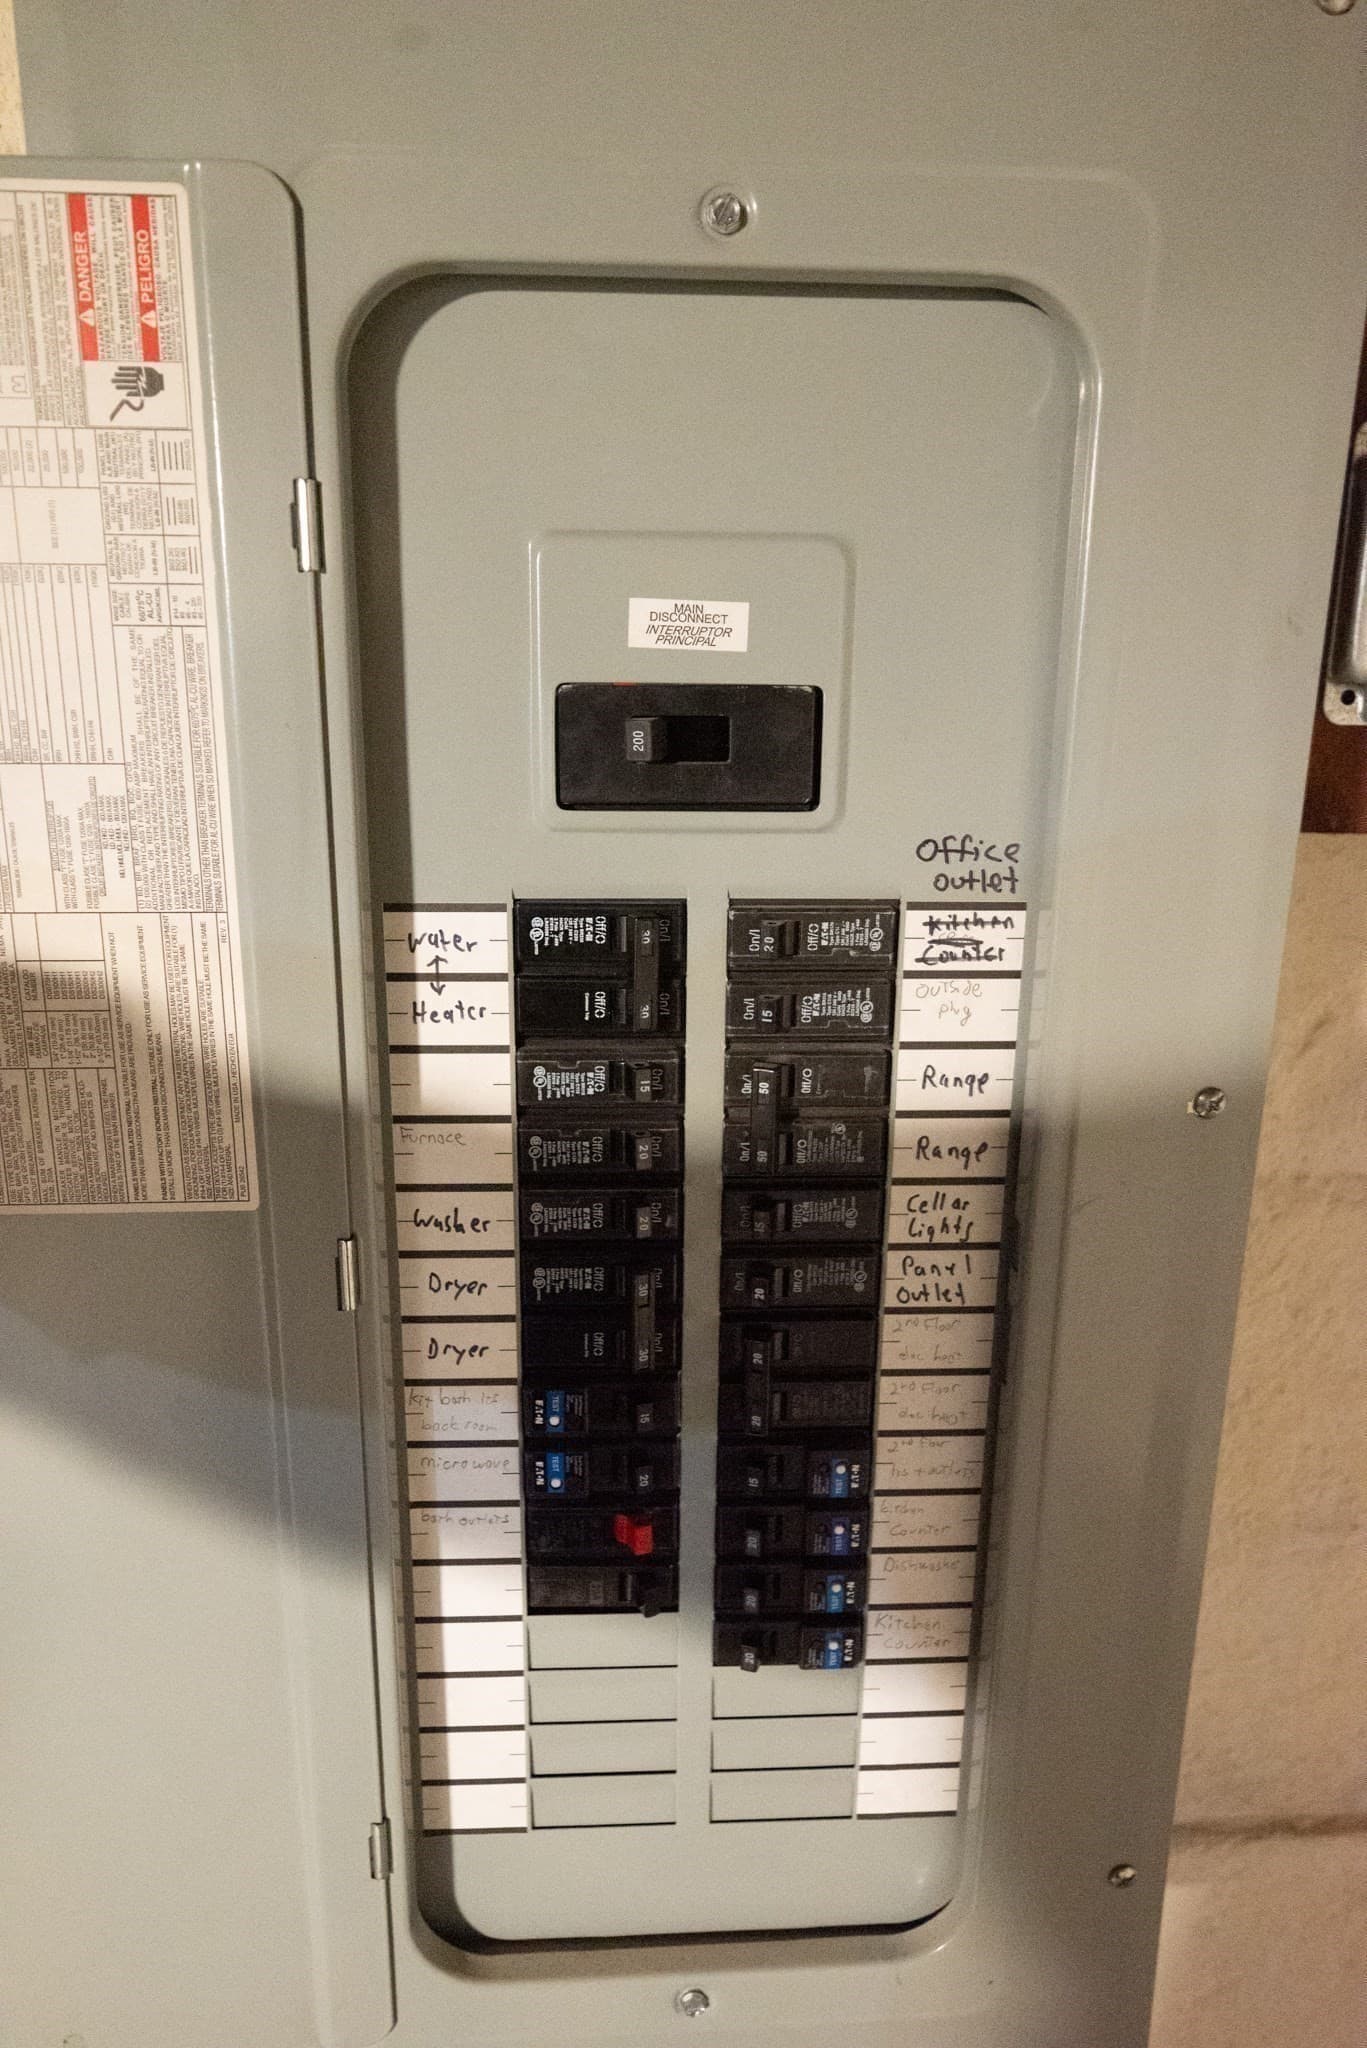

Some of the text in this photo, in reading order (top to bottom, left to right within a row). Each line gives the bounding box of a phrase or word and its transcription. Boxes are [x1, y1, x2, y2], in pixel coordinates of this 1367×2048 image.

[74, 230, 92, 301] DANGER
[136, 229, 153, 303] PELIGRO
[674, 604, 704, 614] MAIN
[650, 611, 728, 624] DISCONNECT
[646, 625, 732, 638] INTERRUPTOR
[656, 635, 717, 646] PRINCIPAL
[184, 634, 194, 664] BREAKER
[633, 731, 644, 752] 200
[199, 810, 208, 838] BREAKER
[201, 839, 209, 855] THAN
[916, 835, 1020, 864] Office
[202, 857, 211, 877] OTHER
[933, 866, 1018, 893] outlet
[641, 929, 649, 944] 30
[764, 937, 774, 952] 20
[412, 1000, 486, 1024] Heater
[640, 1004, 649, 1018] 30
[762, 1010, 773, 1022] 15
[640, 1080, 649, 1093] 15
[921, 1065, 988, 1096] Range
[759, 1082, 769, 1094] 50
[400, 1127, 466, 1145] Furnace
[639, 1145, 648, 1159] 20
[757, 1151, 767, 1162] 50
[916, 1136, 988, 1169] Range
[907, 1192, 970, 1214] Cellar
[639, 1216, 648, 1231] 20
[755, 1222, 764, 1232] 15
[428, 1272, 487, 1300] Dryer
[638, 1283, 648, 1296] 30
[754, 1288, 764, 1299] 20
[427, 1337, 489, 1365] Dryer
[639, 1348, 648, 1361] 30
[753, 1353, 763, 1364] 20
[752, 1416, 760, 1426] 20
[551, 1456, 559, 1472] TEST
[639, 1475, 648, 1486] 20
[748, 1478, 758, 1488] 15
[748, 1537, 756, 1548] 20
[746, 1596, 756, 1608] 20
[744, 1653, 754, 1664] 20
